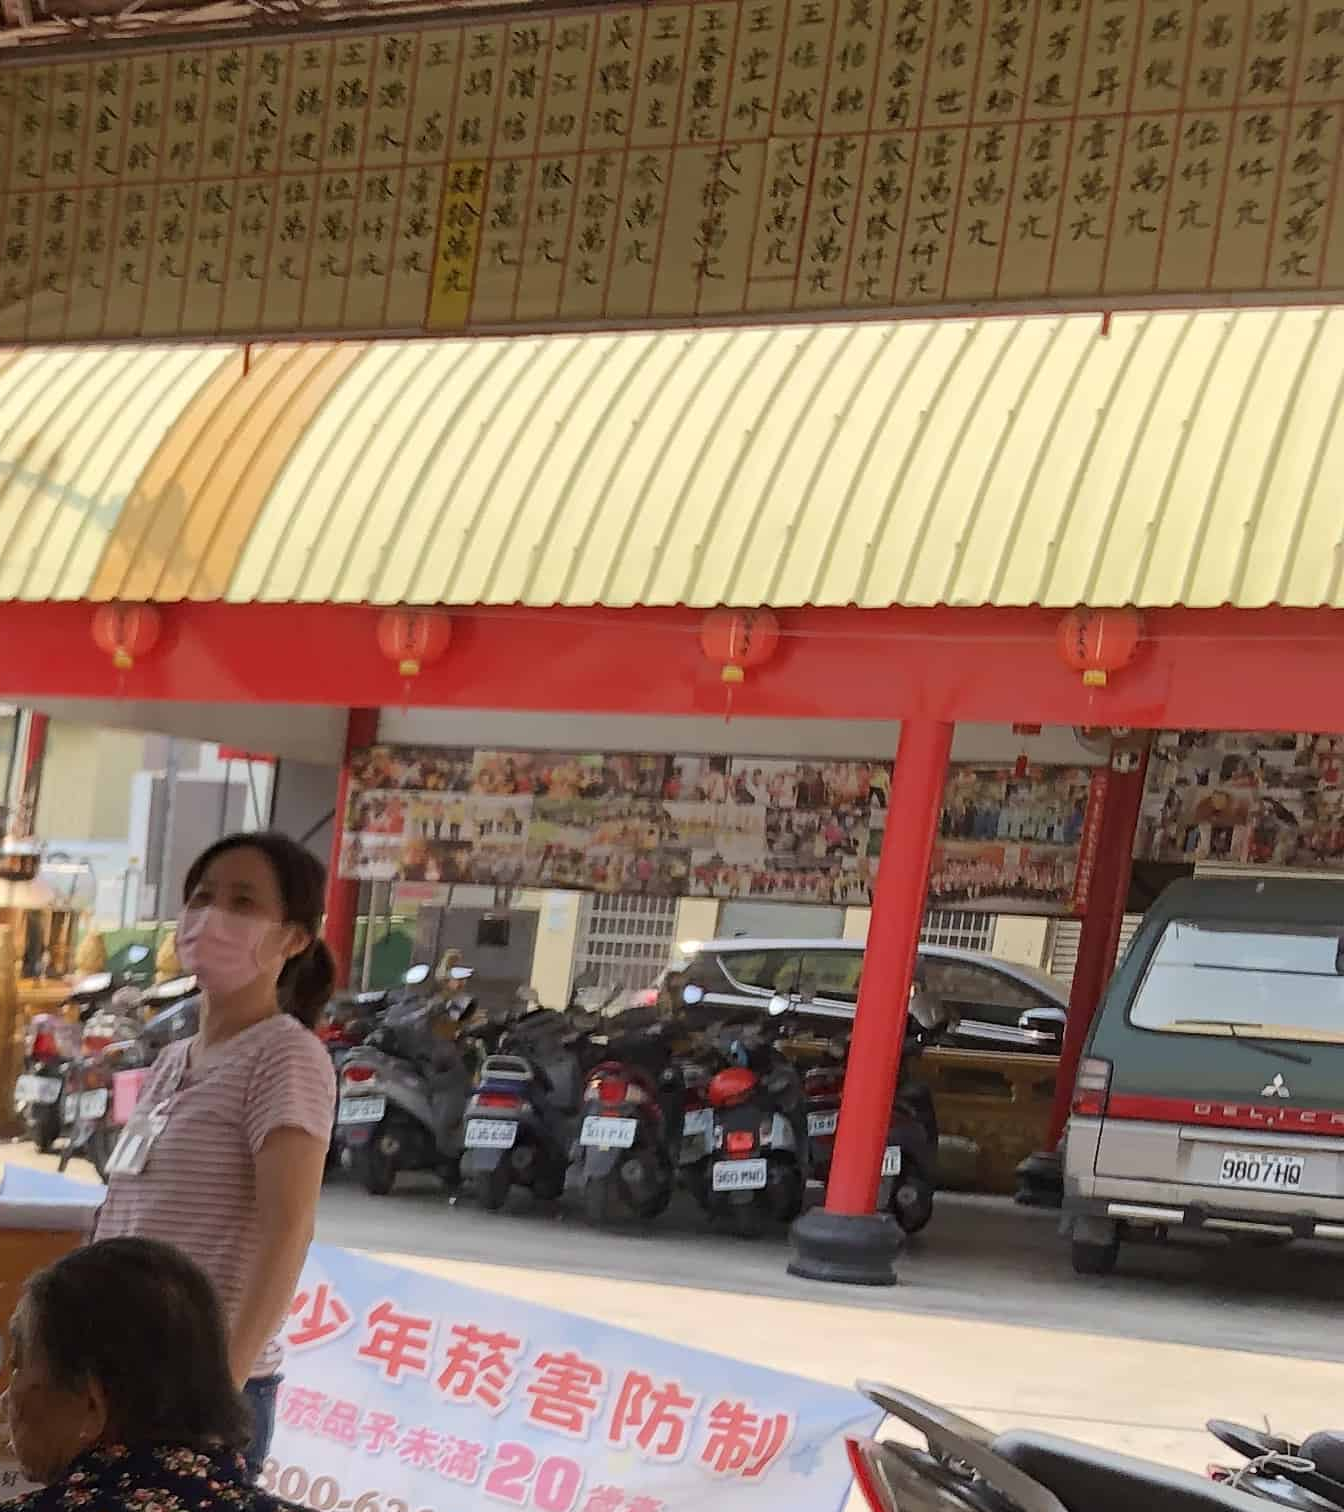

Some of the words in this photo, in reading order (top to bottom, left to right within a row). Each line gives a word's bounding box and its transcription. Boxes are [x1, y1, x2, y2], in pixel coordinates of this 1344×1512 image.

[1222, 1158, 1301, 1185] 9807HQ
[285, 1282, 793, 1478] 少年菸害防制
